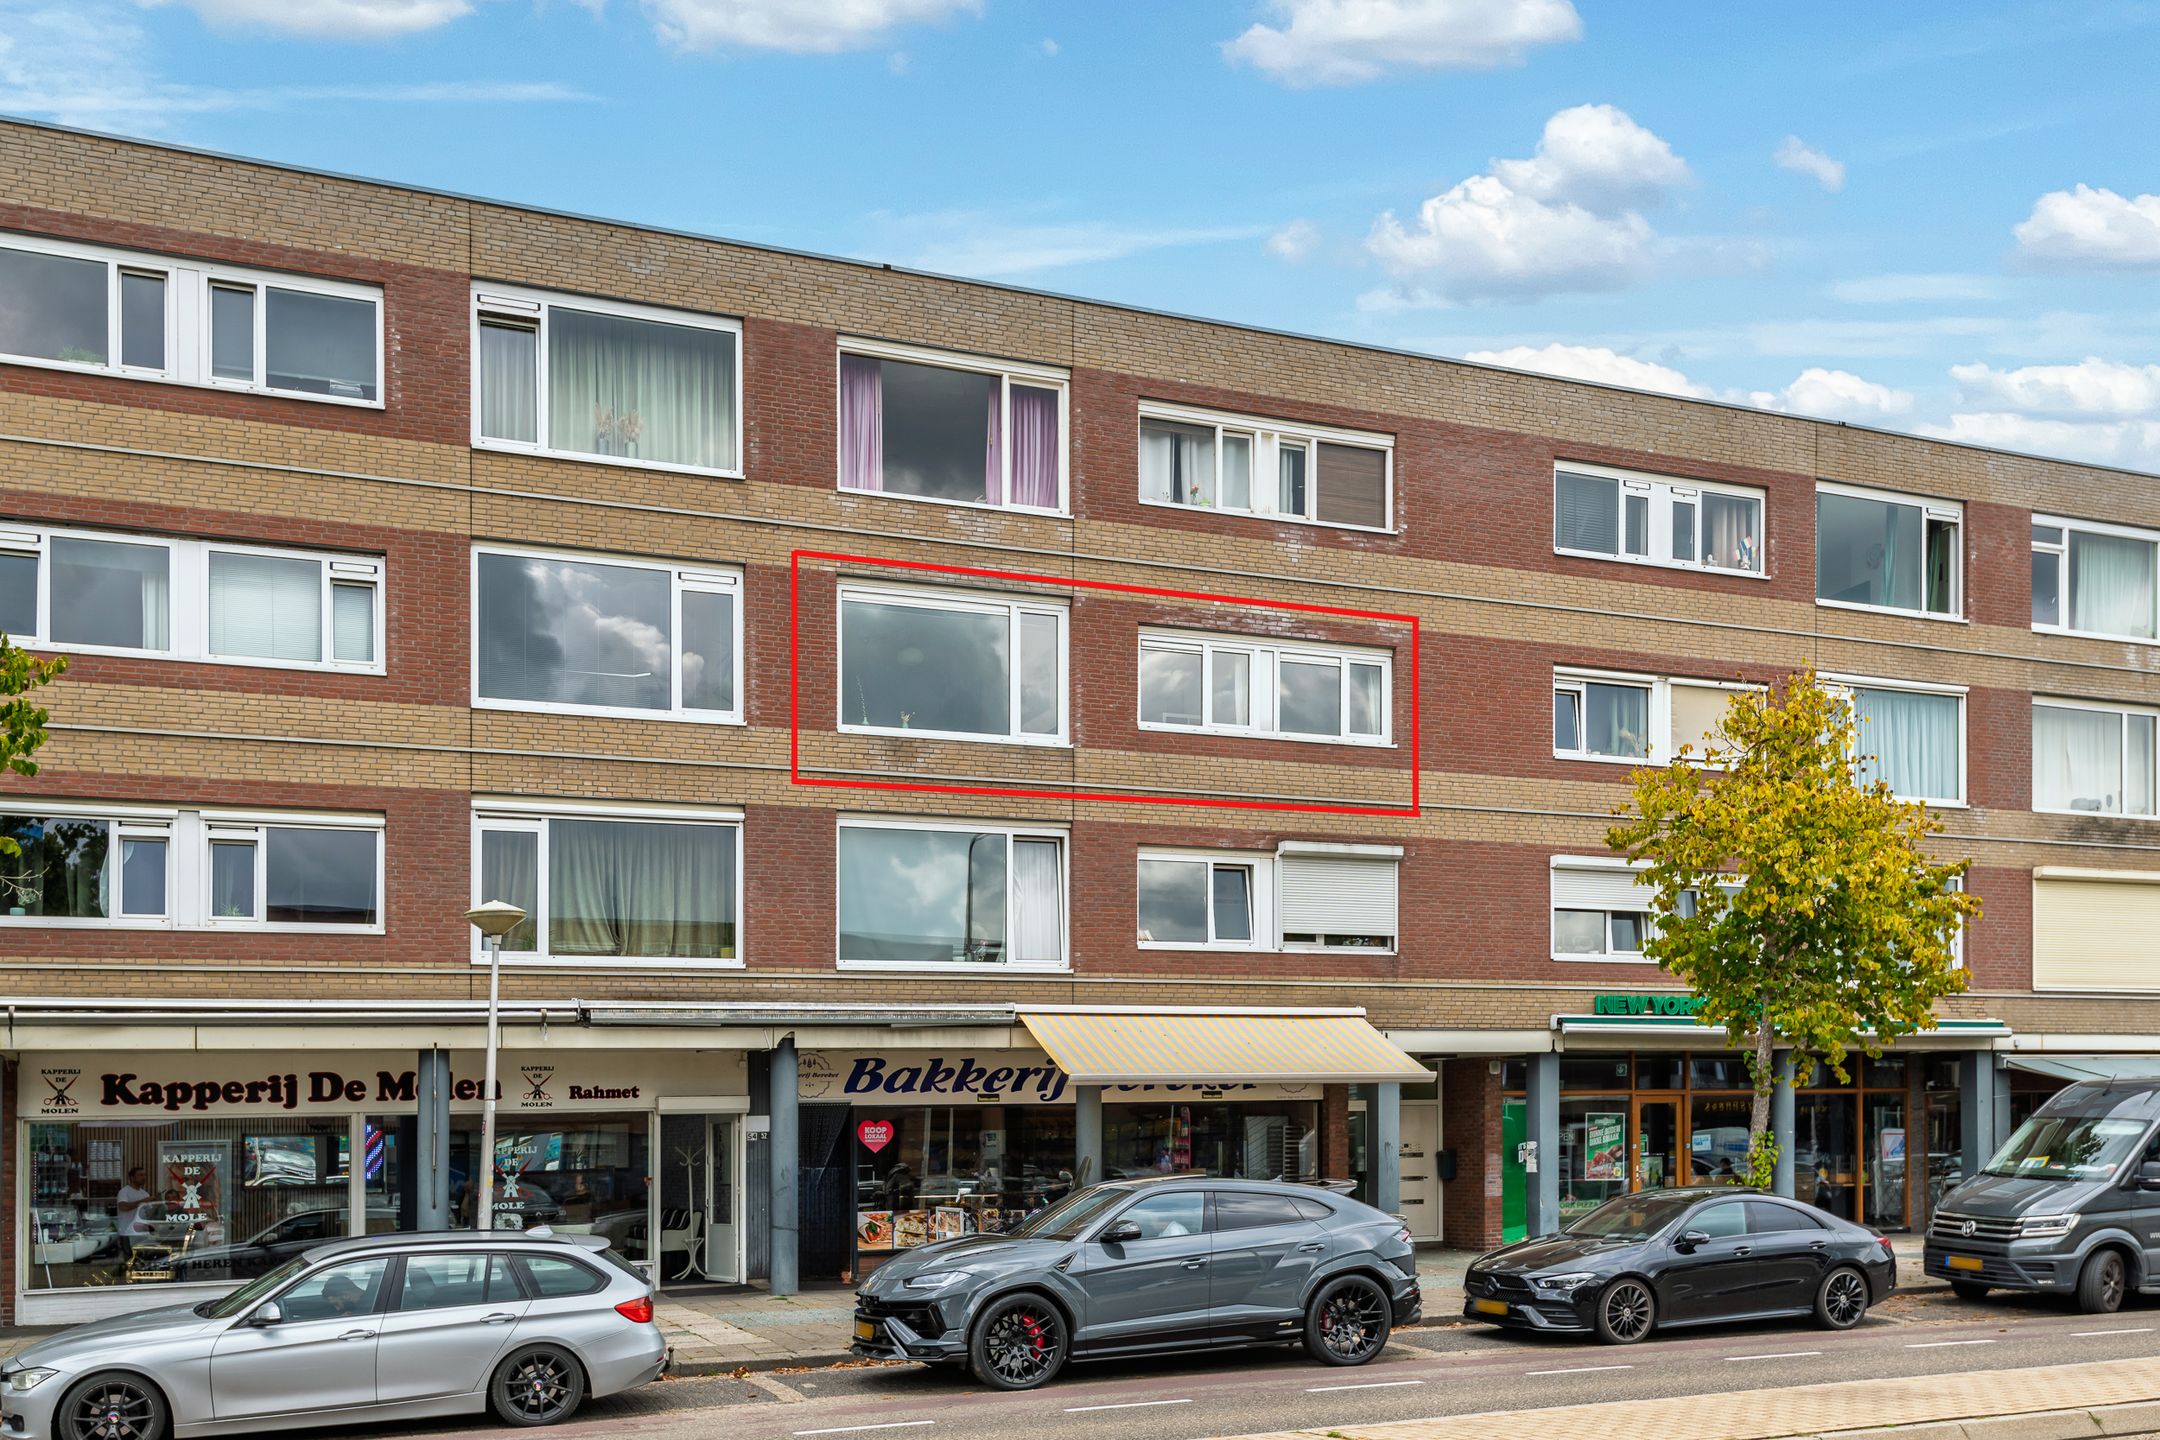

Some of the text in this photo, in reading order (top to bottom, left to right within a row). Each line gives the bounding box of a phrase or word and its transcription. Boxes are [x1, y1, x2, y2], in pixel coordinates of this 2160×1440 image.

[1595, 995, 1649, 1015] NEW
[844, 1057, 1070, 1102] Bakkerij
[100, 1073, 298, 1111] Kapperij
[307, 1071, 367, 1102] De
[569, 1085, 640, 1100] Rahmet
[864, 1126, 887, 1134] KOOP
[1560, 1132, 1575, 1141] PEN
[162, 1153, 222, 1163] KAPPERIJ
[504, 1158, 518, 1166] DE
[184, 1167, 200, 1176] DE
